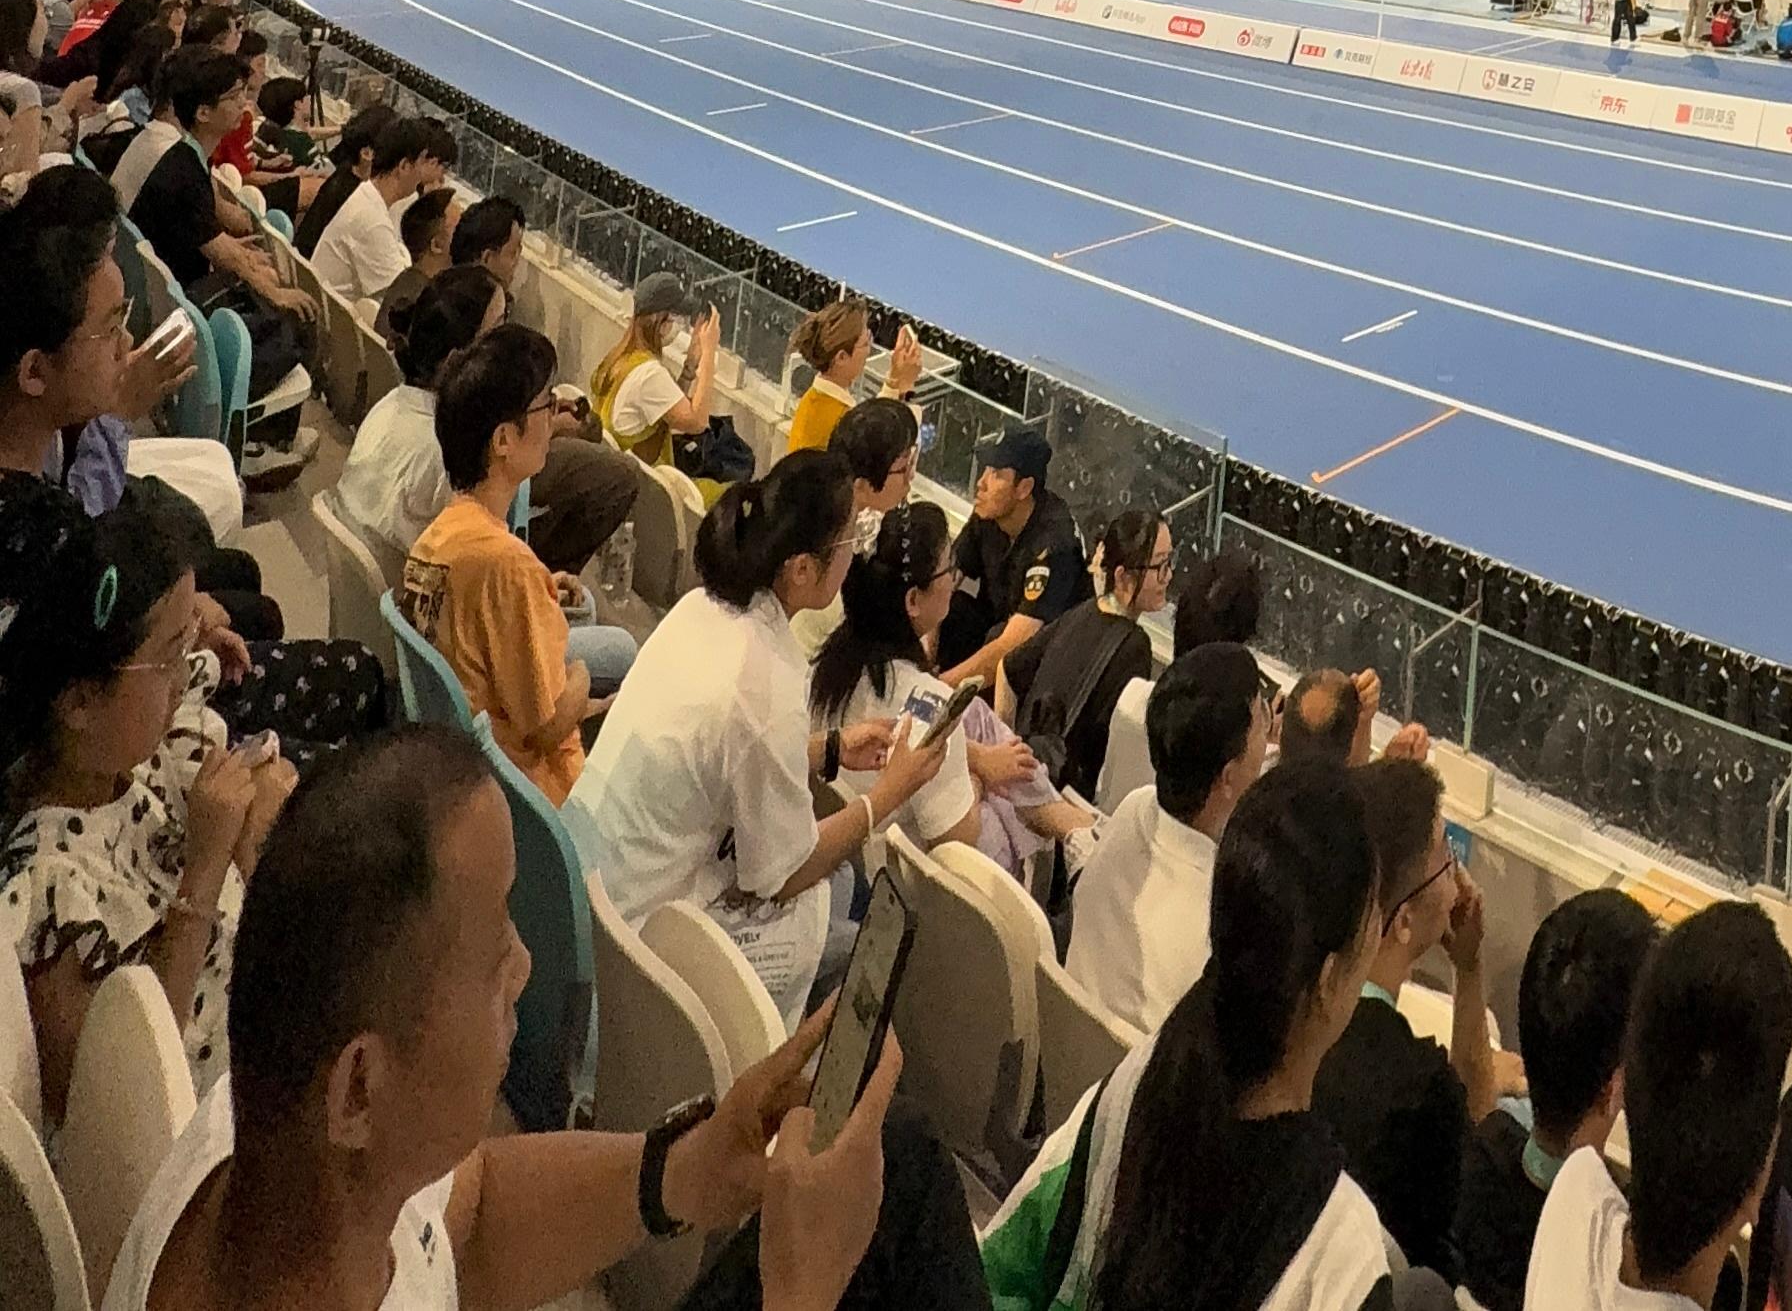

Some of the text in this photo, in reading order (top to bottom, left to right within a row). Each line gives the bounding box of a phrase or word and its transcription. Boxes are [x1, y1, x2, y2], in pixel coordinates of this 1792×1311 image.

[1498, 73, 1536, 92] 慧之安
[1599, 96, 1628, 115] 京东
[1693, 106, 1737, 126] 首钢基金
